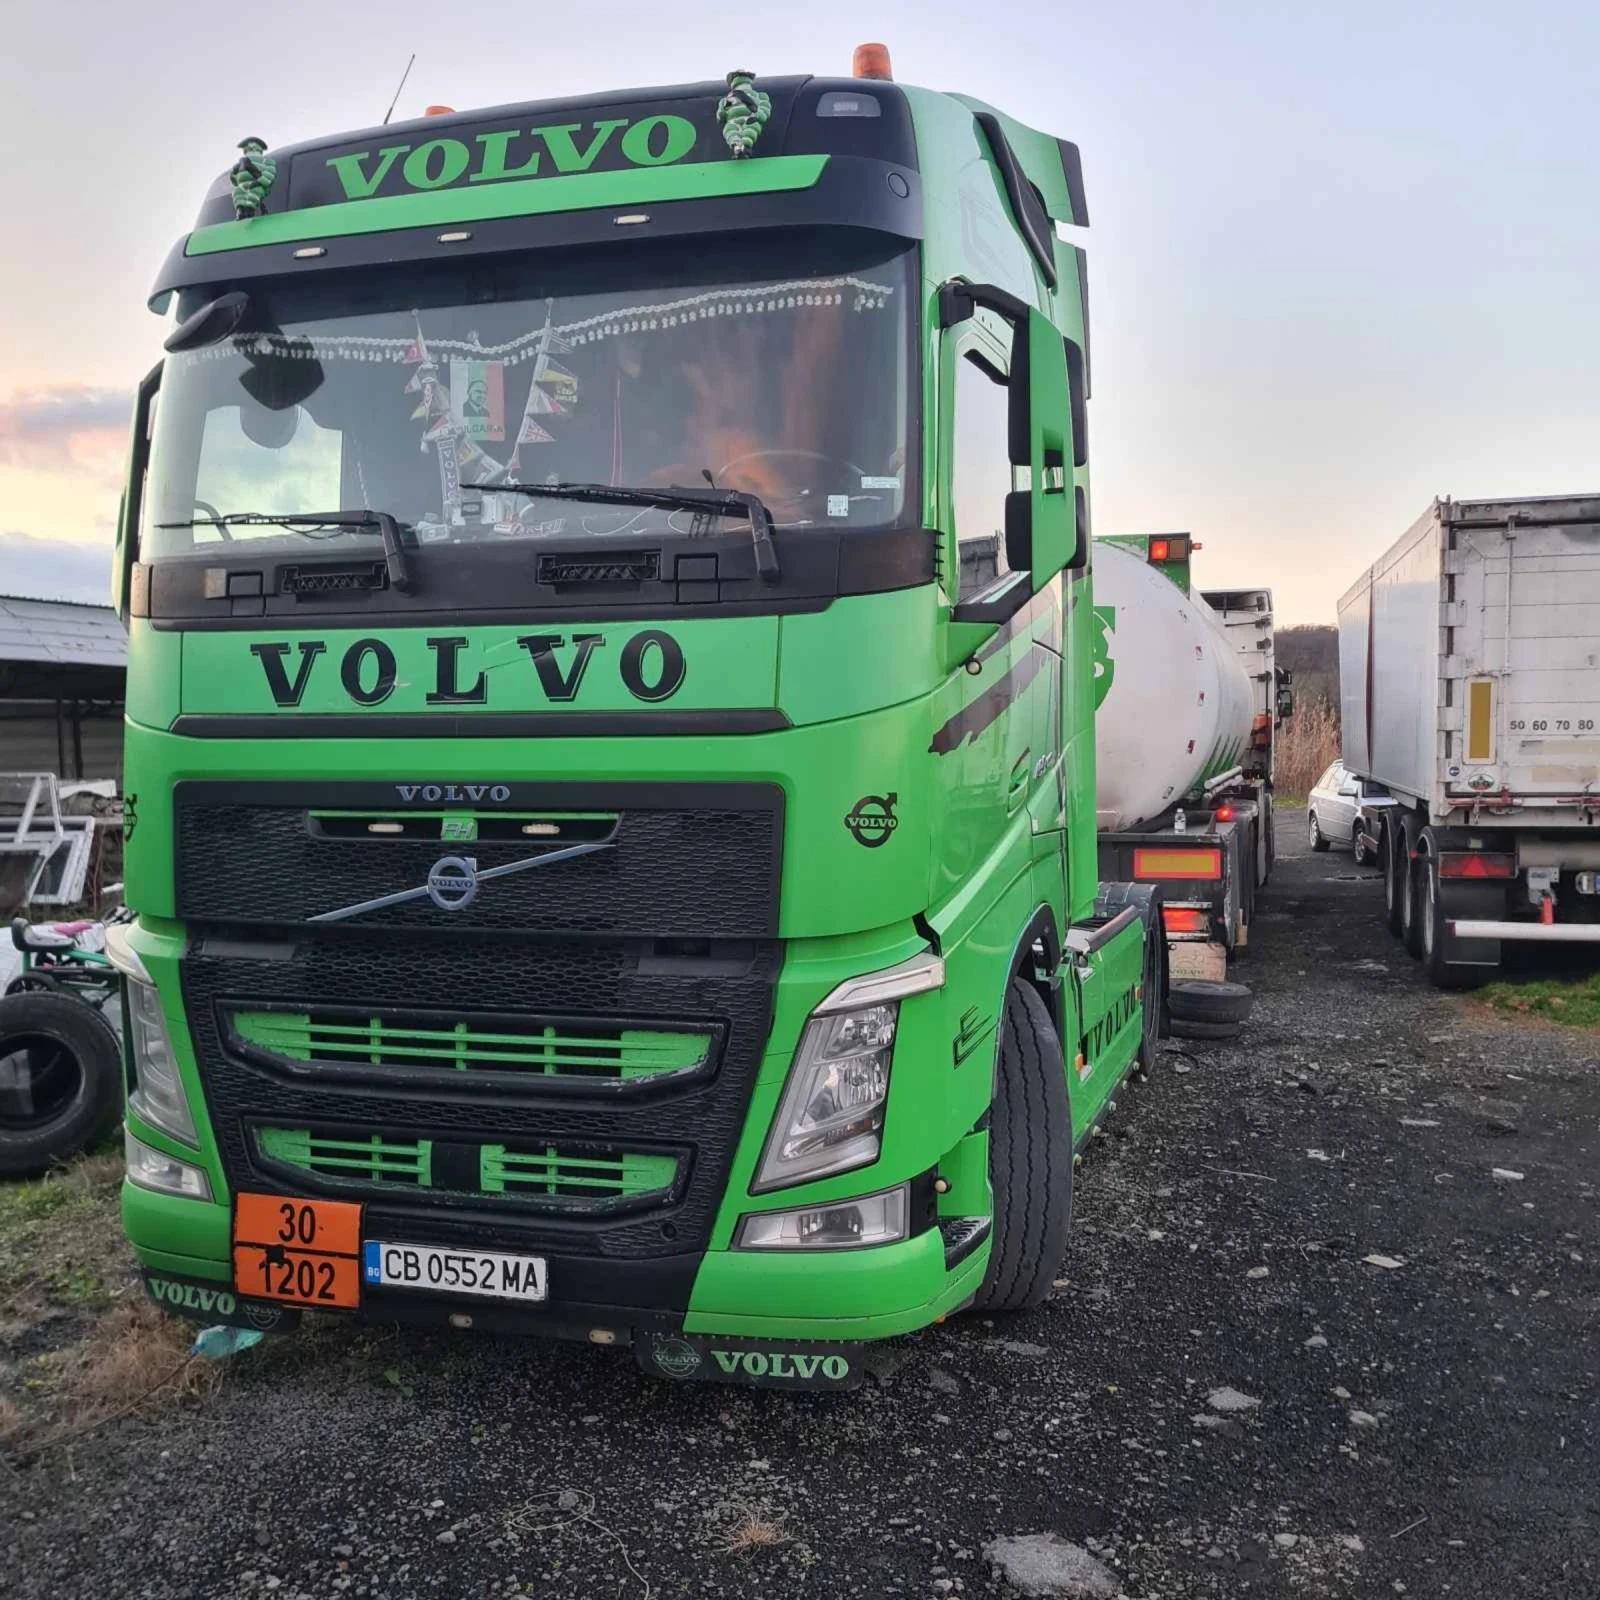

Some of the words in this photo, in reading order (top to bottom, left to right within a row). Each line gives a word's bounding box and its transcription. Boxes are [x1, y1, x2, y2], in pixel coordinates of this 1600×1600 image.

[326, 114, 697, 199] VOLVO
[249, 629, 687, 707] VOLVO
[1510, 720, 1525, 730] 50
[1532, 720, 1548, 731] 60
[1556, 720, 1570, 730] 70
[1578, 719, 1594, 730] 80
[395, 785, 511, 801] VOLVO
[441, 822, 475, 841] FH
[847, 817, 897, 828] VOLVO
[431, 880, 473, 889] VOLVO
[1093, 982, 1136, 1059] VOLVO
[278, 1203, 316, 1244] 30
[259, 1259, 336, 1300] 1202
[367, 1266, 380, 1277] BG
[385, 1249, 421, 1282] CB
[427, 1252, 496, 1290] 0552
[502, 1259, 539, 1294] MA
[148, 1278, 236, 1315] VOLVO
[244, 1303, 282, 1316] VOLVO
[655, 1354, 701, 1363] VOLVO
[710, 1350, 849, 1380] VOLVO
